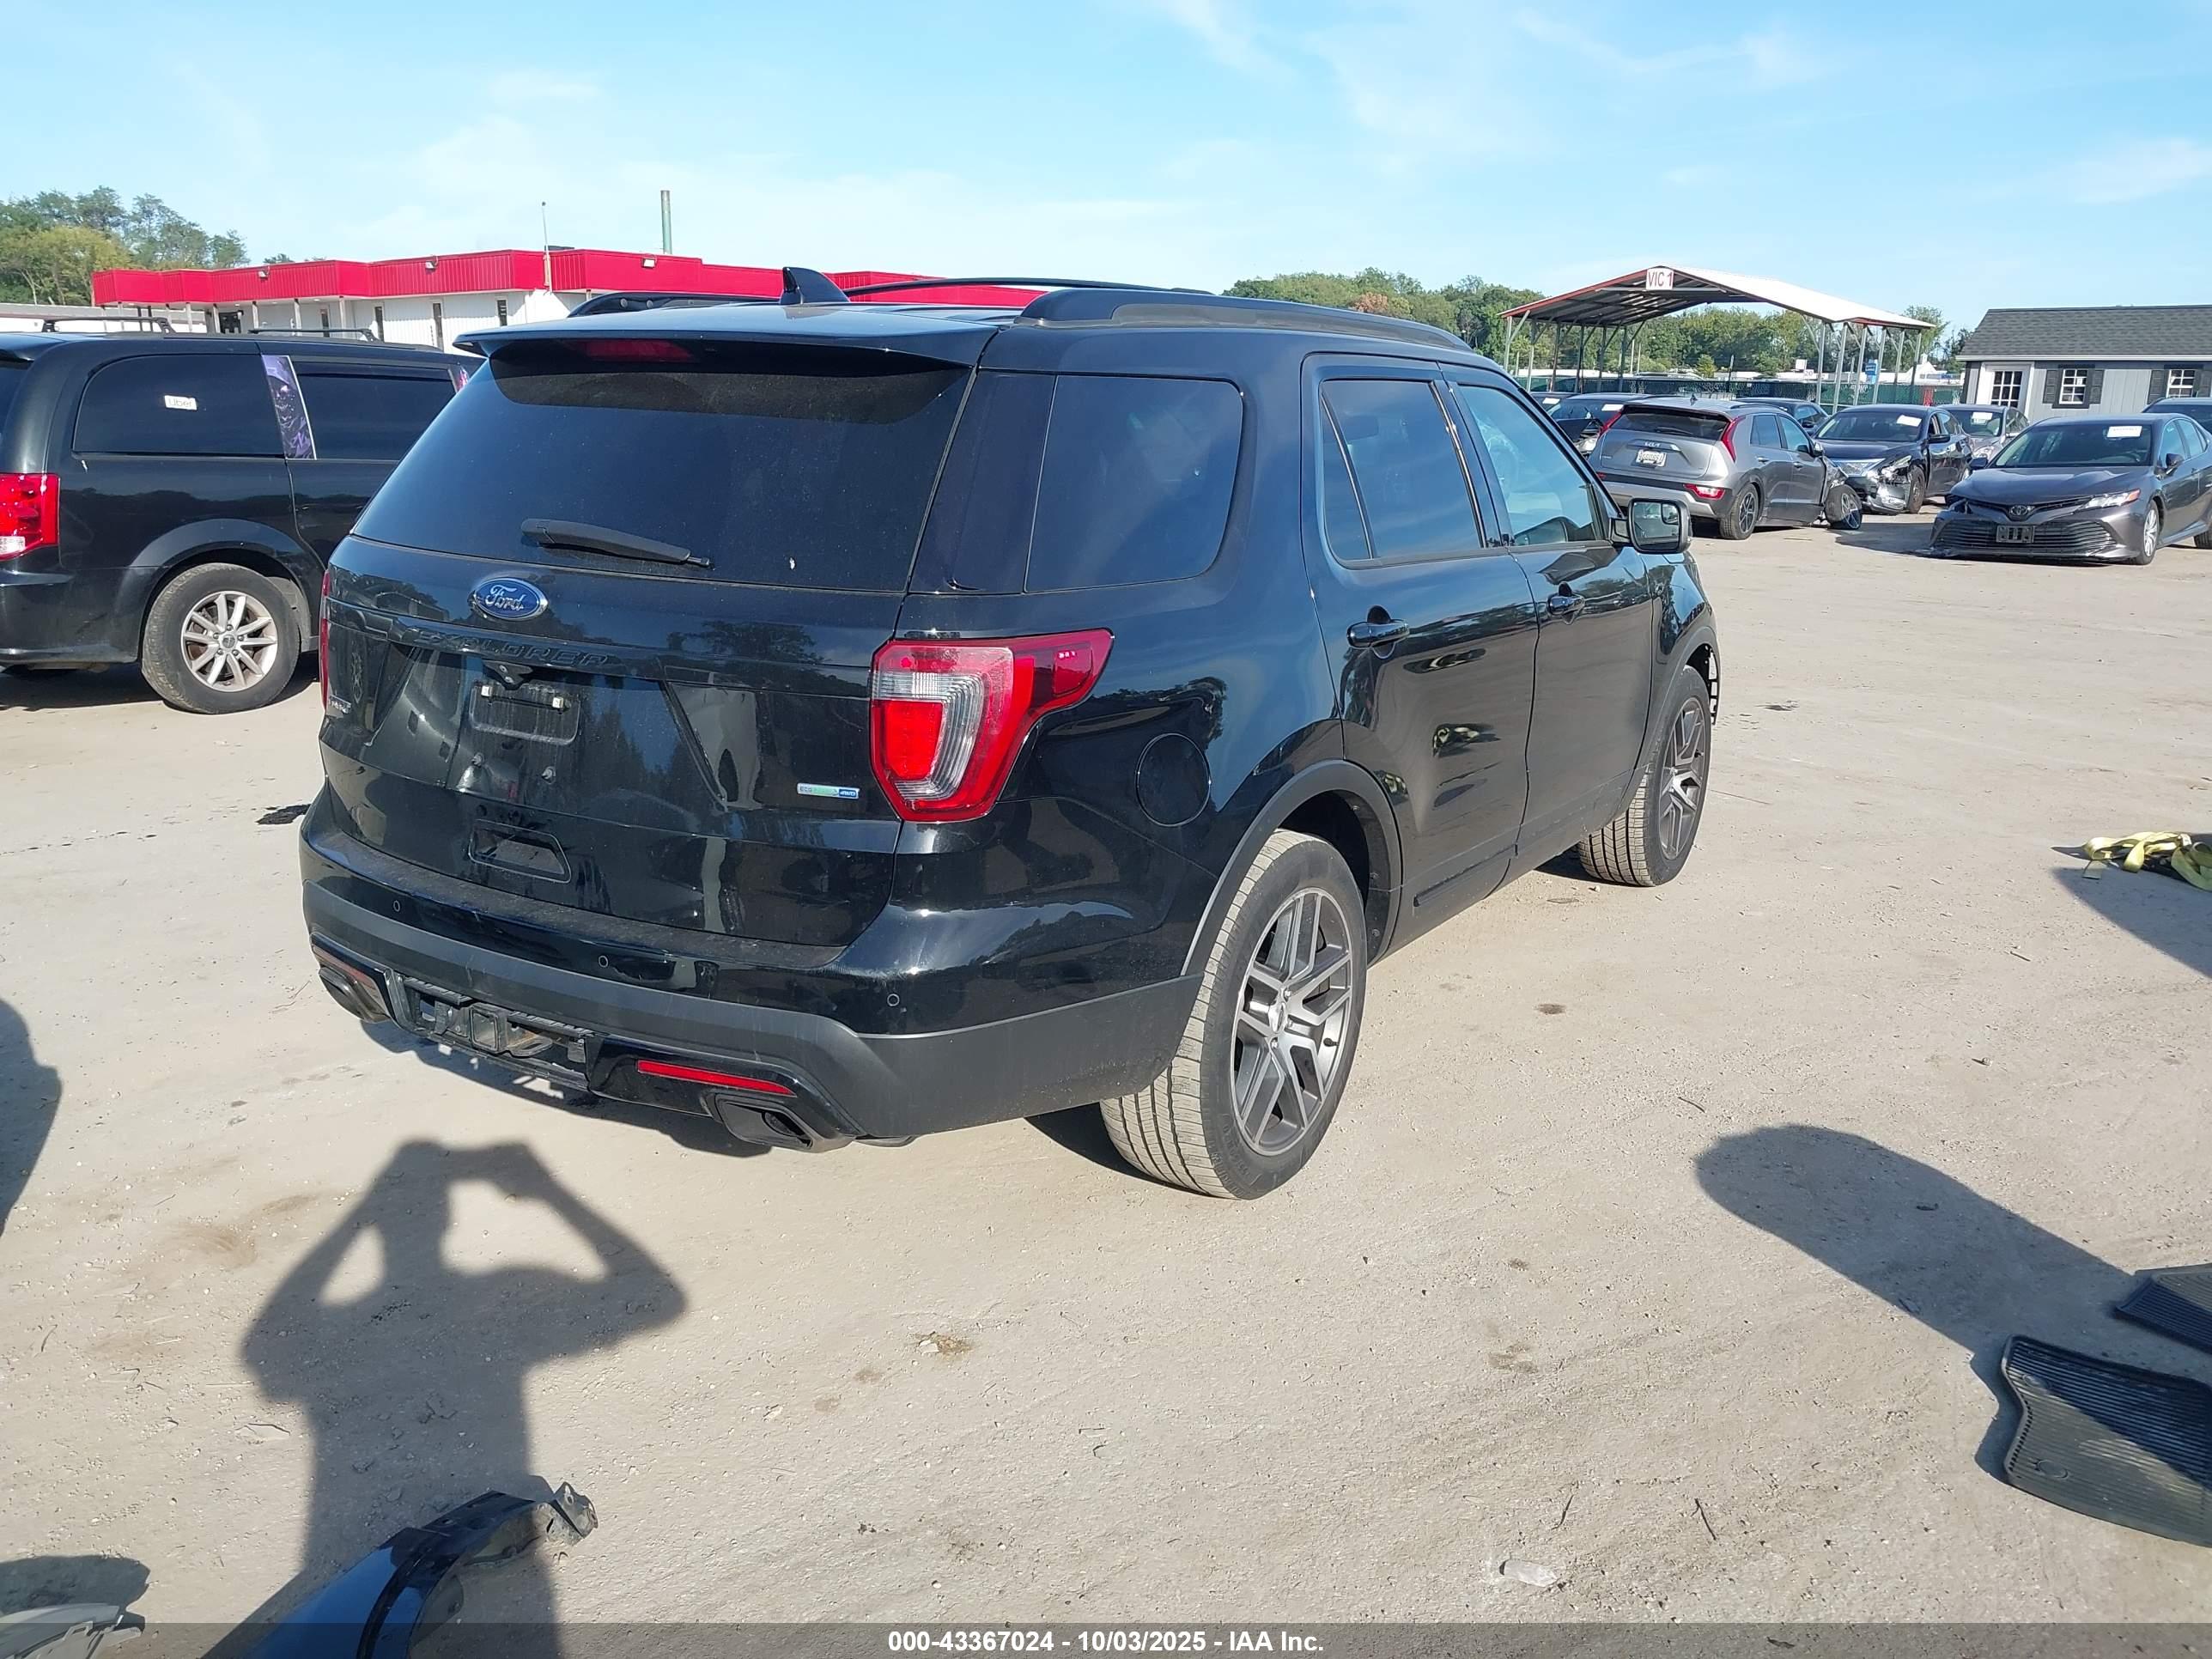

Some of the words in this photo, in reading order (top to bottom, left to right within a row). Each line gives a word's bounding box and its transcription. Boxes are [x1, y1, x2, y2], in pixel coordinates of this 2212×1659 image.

[1648, 271, 1664, 287] VIC
[1667, 271, 1673, 287] 1
[167, 398, 193, 408] Uber
[484, 584, 526, 611] Ford
[412, 632, 610, 667] EXPLORER
